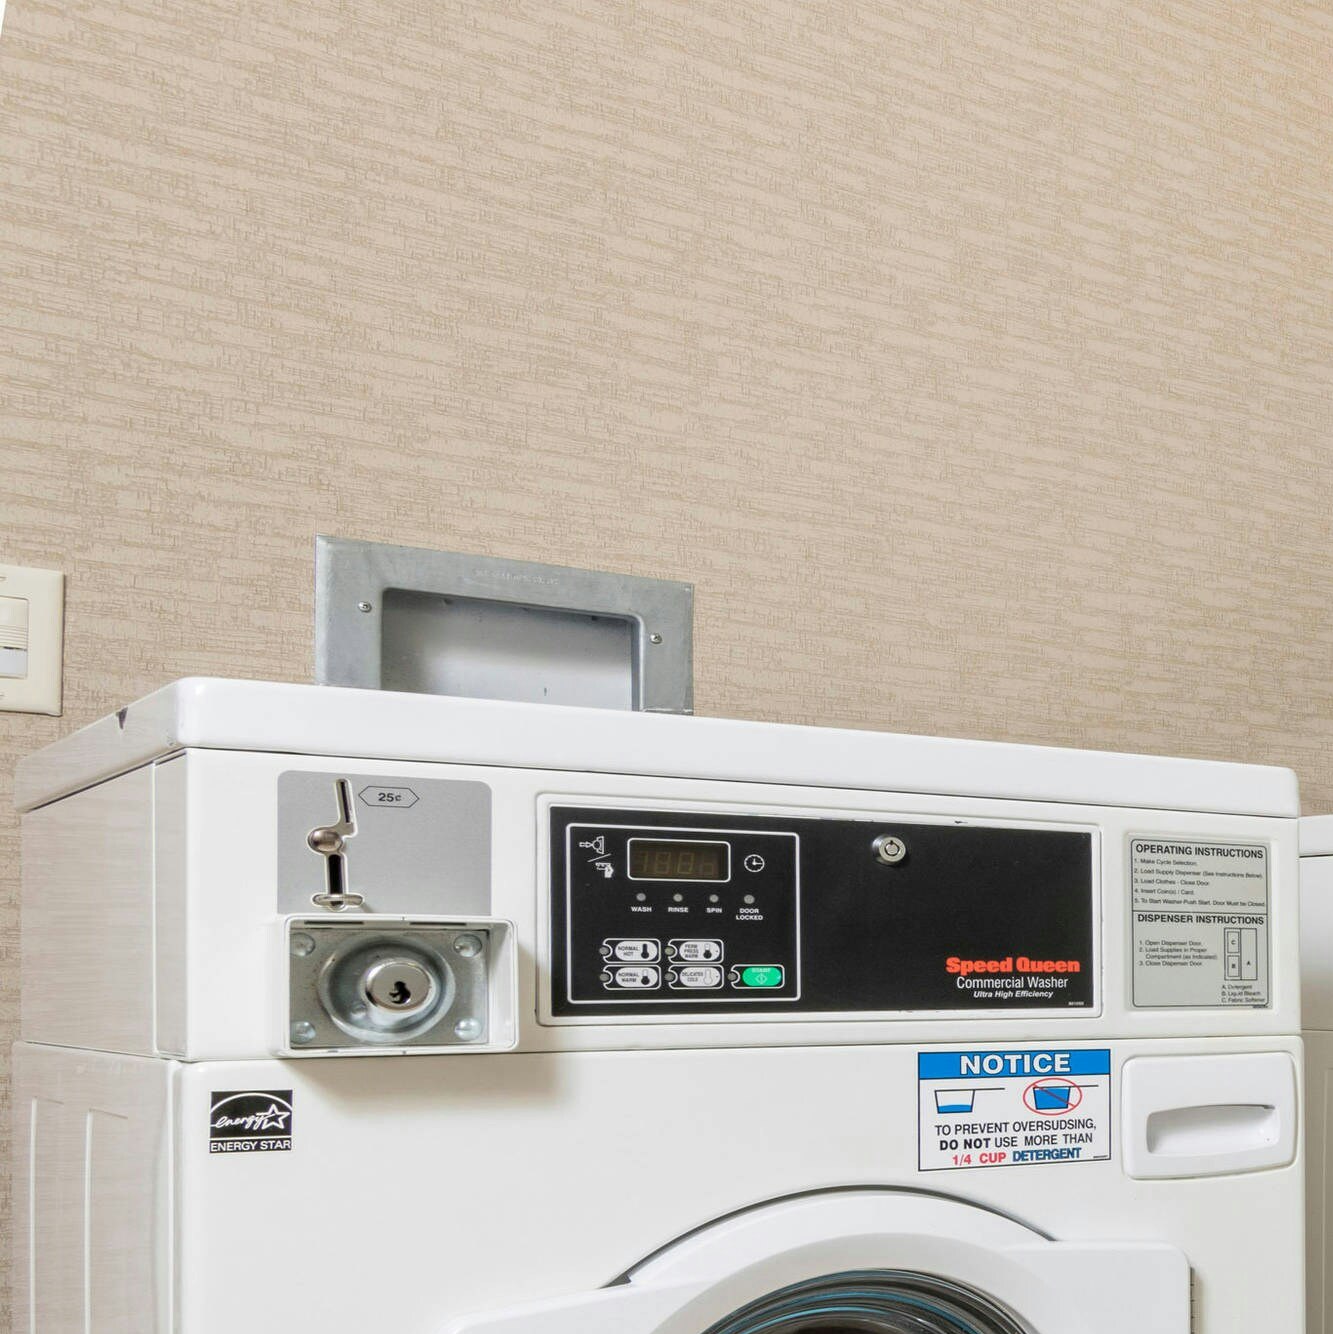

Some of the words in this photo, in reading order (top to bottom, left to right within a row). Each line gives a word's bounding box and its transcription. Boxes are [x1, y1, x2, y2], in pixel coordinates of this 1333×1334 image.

[1136, 844, 1192, 855] OPERATING
[1195, 846, 1263, 858] INSTRUCTIONS
[1138, 914, 1193, 923] DISPENSER
[1196, 915, 1264, 925] INSTRUCTIONS
[946, 957, 1013, 976] Speed
[1016, 957, 1080, 972] Queen
[957, 977, 1024, 989] Commercial
[1028, 977, 1068, 988] Washer
[995, 991, 1013, 999] High
[960, 1053, 1071, 1075] NOTICE
[935, 1124, 950, 1135] TO
[955, 1122, 1009, 1135] PREVENT
[1013, 1118, 1096, 1132] OVERSUDSING,
[211, 1141, 258, 1151] ENERGY
[260, 1140, 291, 1150] STAR
[940, 1140, 958, 1150] DO
[964, 1138, 991, 1149] NOT
[995, 1137, 1017, 1147] USE
[1024, 1135, 1057, 1146] MORE
[1063, 1133, 1092, 1144] THAN
[952, 1154, 971, 1166] 1/4
[979, 1152, 1006, 1164] CUP
[1012, 1147, 1082, 1162] DETERGENT
